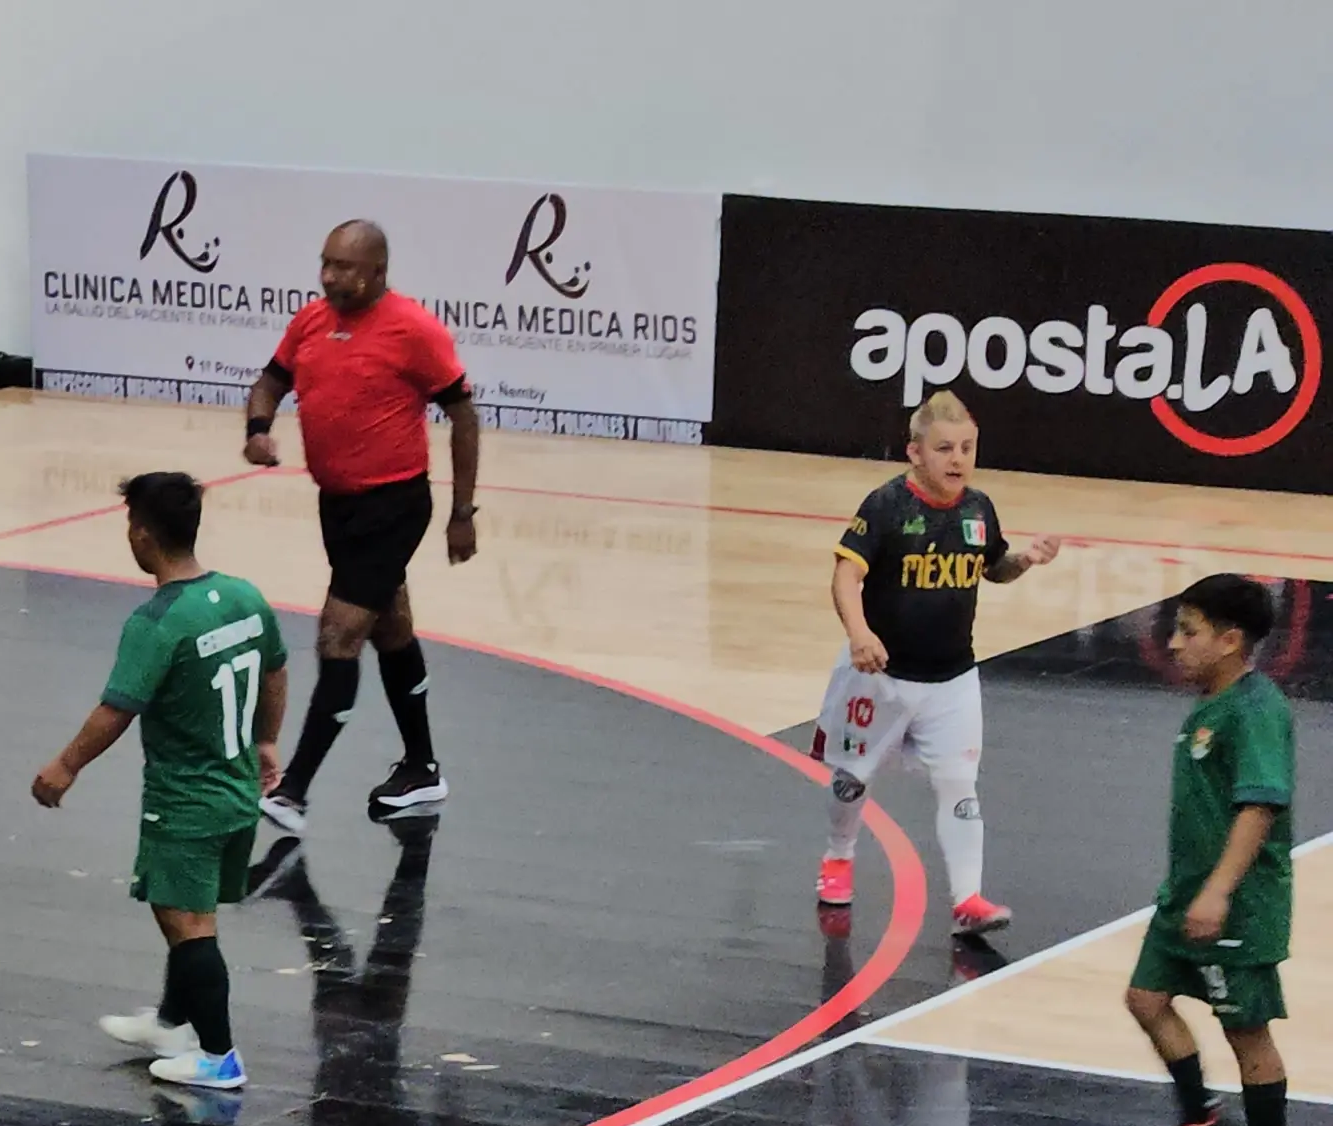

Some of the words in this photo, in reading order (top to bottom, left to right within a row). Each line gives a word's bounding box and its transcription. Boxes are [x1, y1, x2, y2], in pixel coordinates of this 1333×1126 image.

[44, 271, 144, 305] CLINICA
[152, 279, 254, 313] MEDICA
[107, 306, 131, 320] DEL
[422, 298, 508, 331] INICA
[518, 304, 623, 339] MEDICA
[634, 312, 697, 345] RIOS
[215, 361, 264, 381] Proyec
[901, 543, 985, 589] MÉXICO
[211, 649, 261, 760] 17
[846, 696, 874, 728] 10
